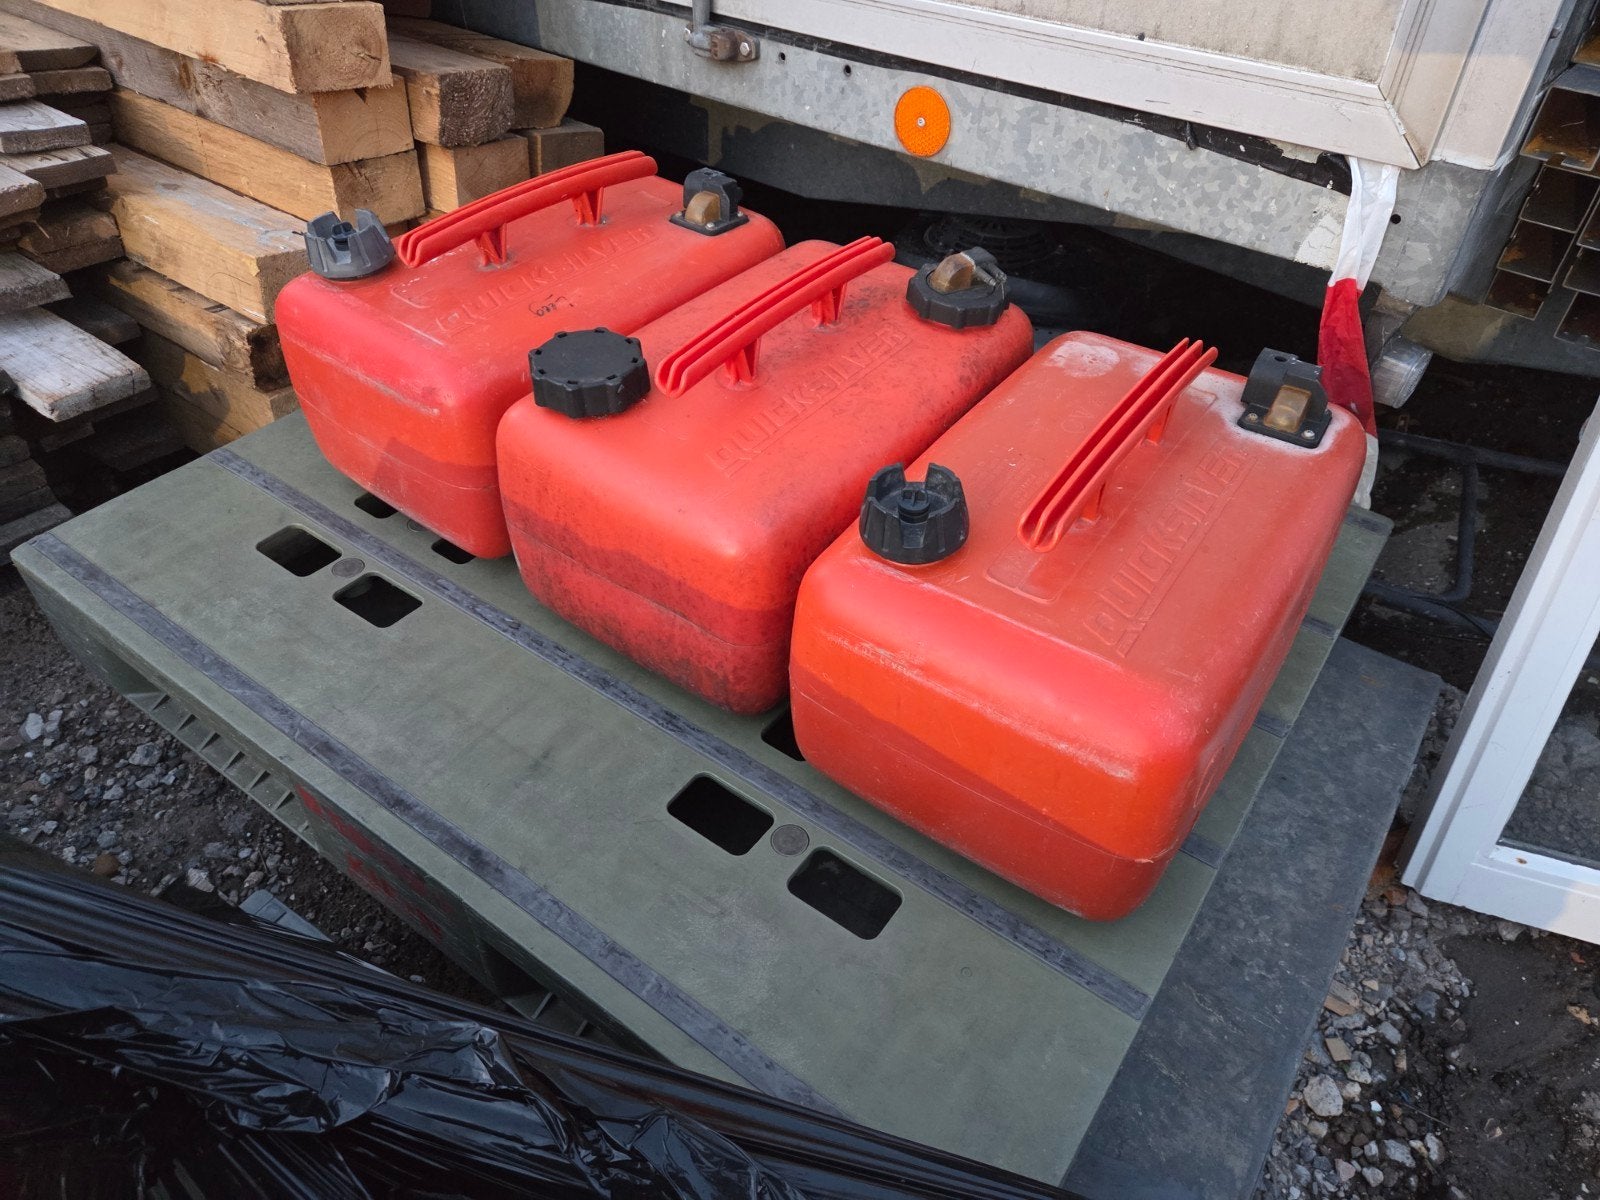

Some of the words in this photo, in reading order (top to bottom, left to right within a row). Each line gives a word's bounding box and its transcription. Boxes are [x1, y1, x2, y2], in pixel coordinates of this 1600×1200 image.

[434, 227, 655, 335] QUICKSILVER
[704, 323, 908, 475] QUICKSILVER
[1083, 442, 1250, 652] QUICKSILVER
